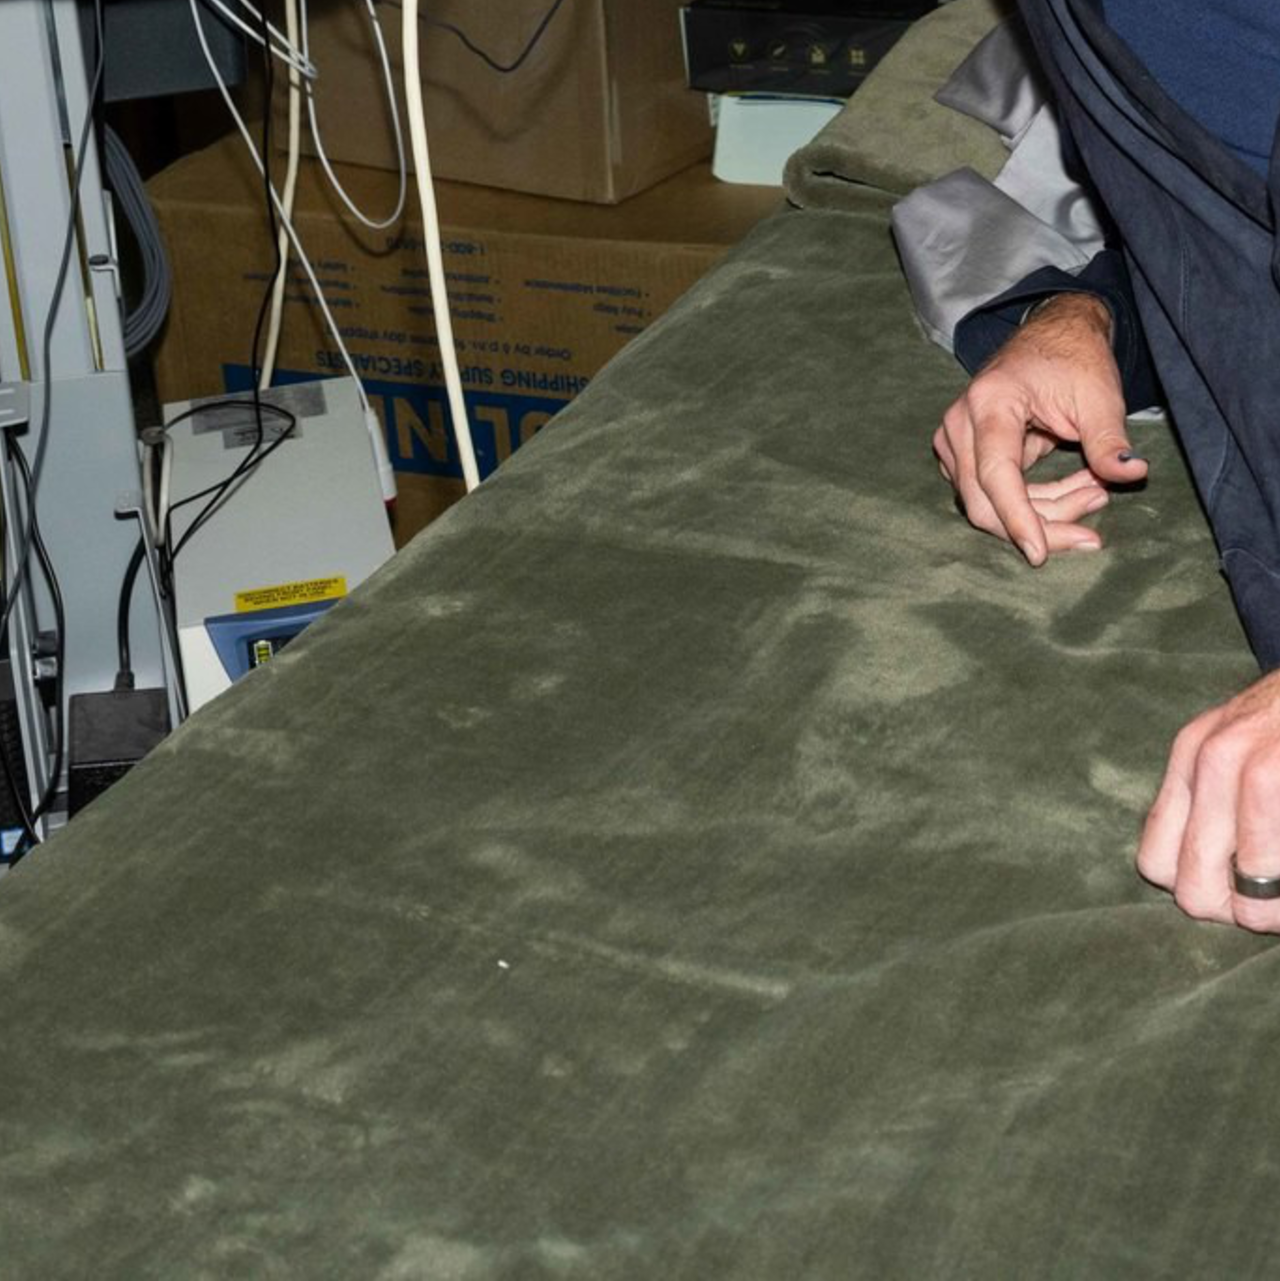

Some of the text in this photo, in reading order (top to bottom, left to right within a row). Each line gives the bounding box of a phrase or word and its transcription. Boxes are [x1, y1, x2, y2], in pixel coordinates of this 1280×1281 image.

[513, 344, 531, 357] by
[534, 346, 572, 361] Order
[501, 368, 591, 393] SHIPPING
